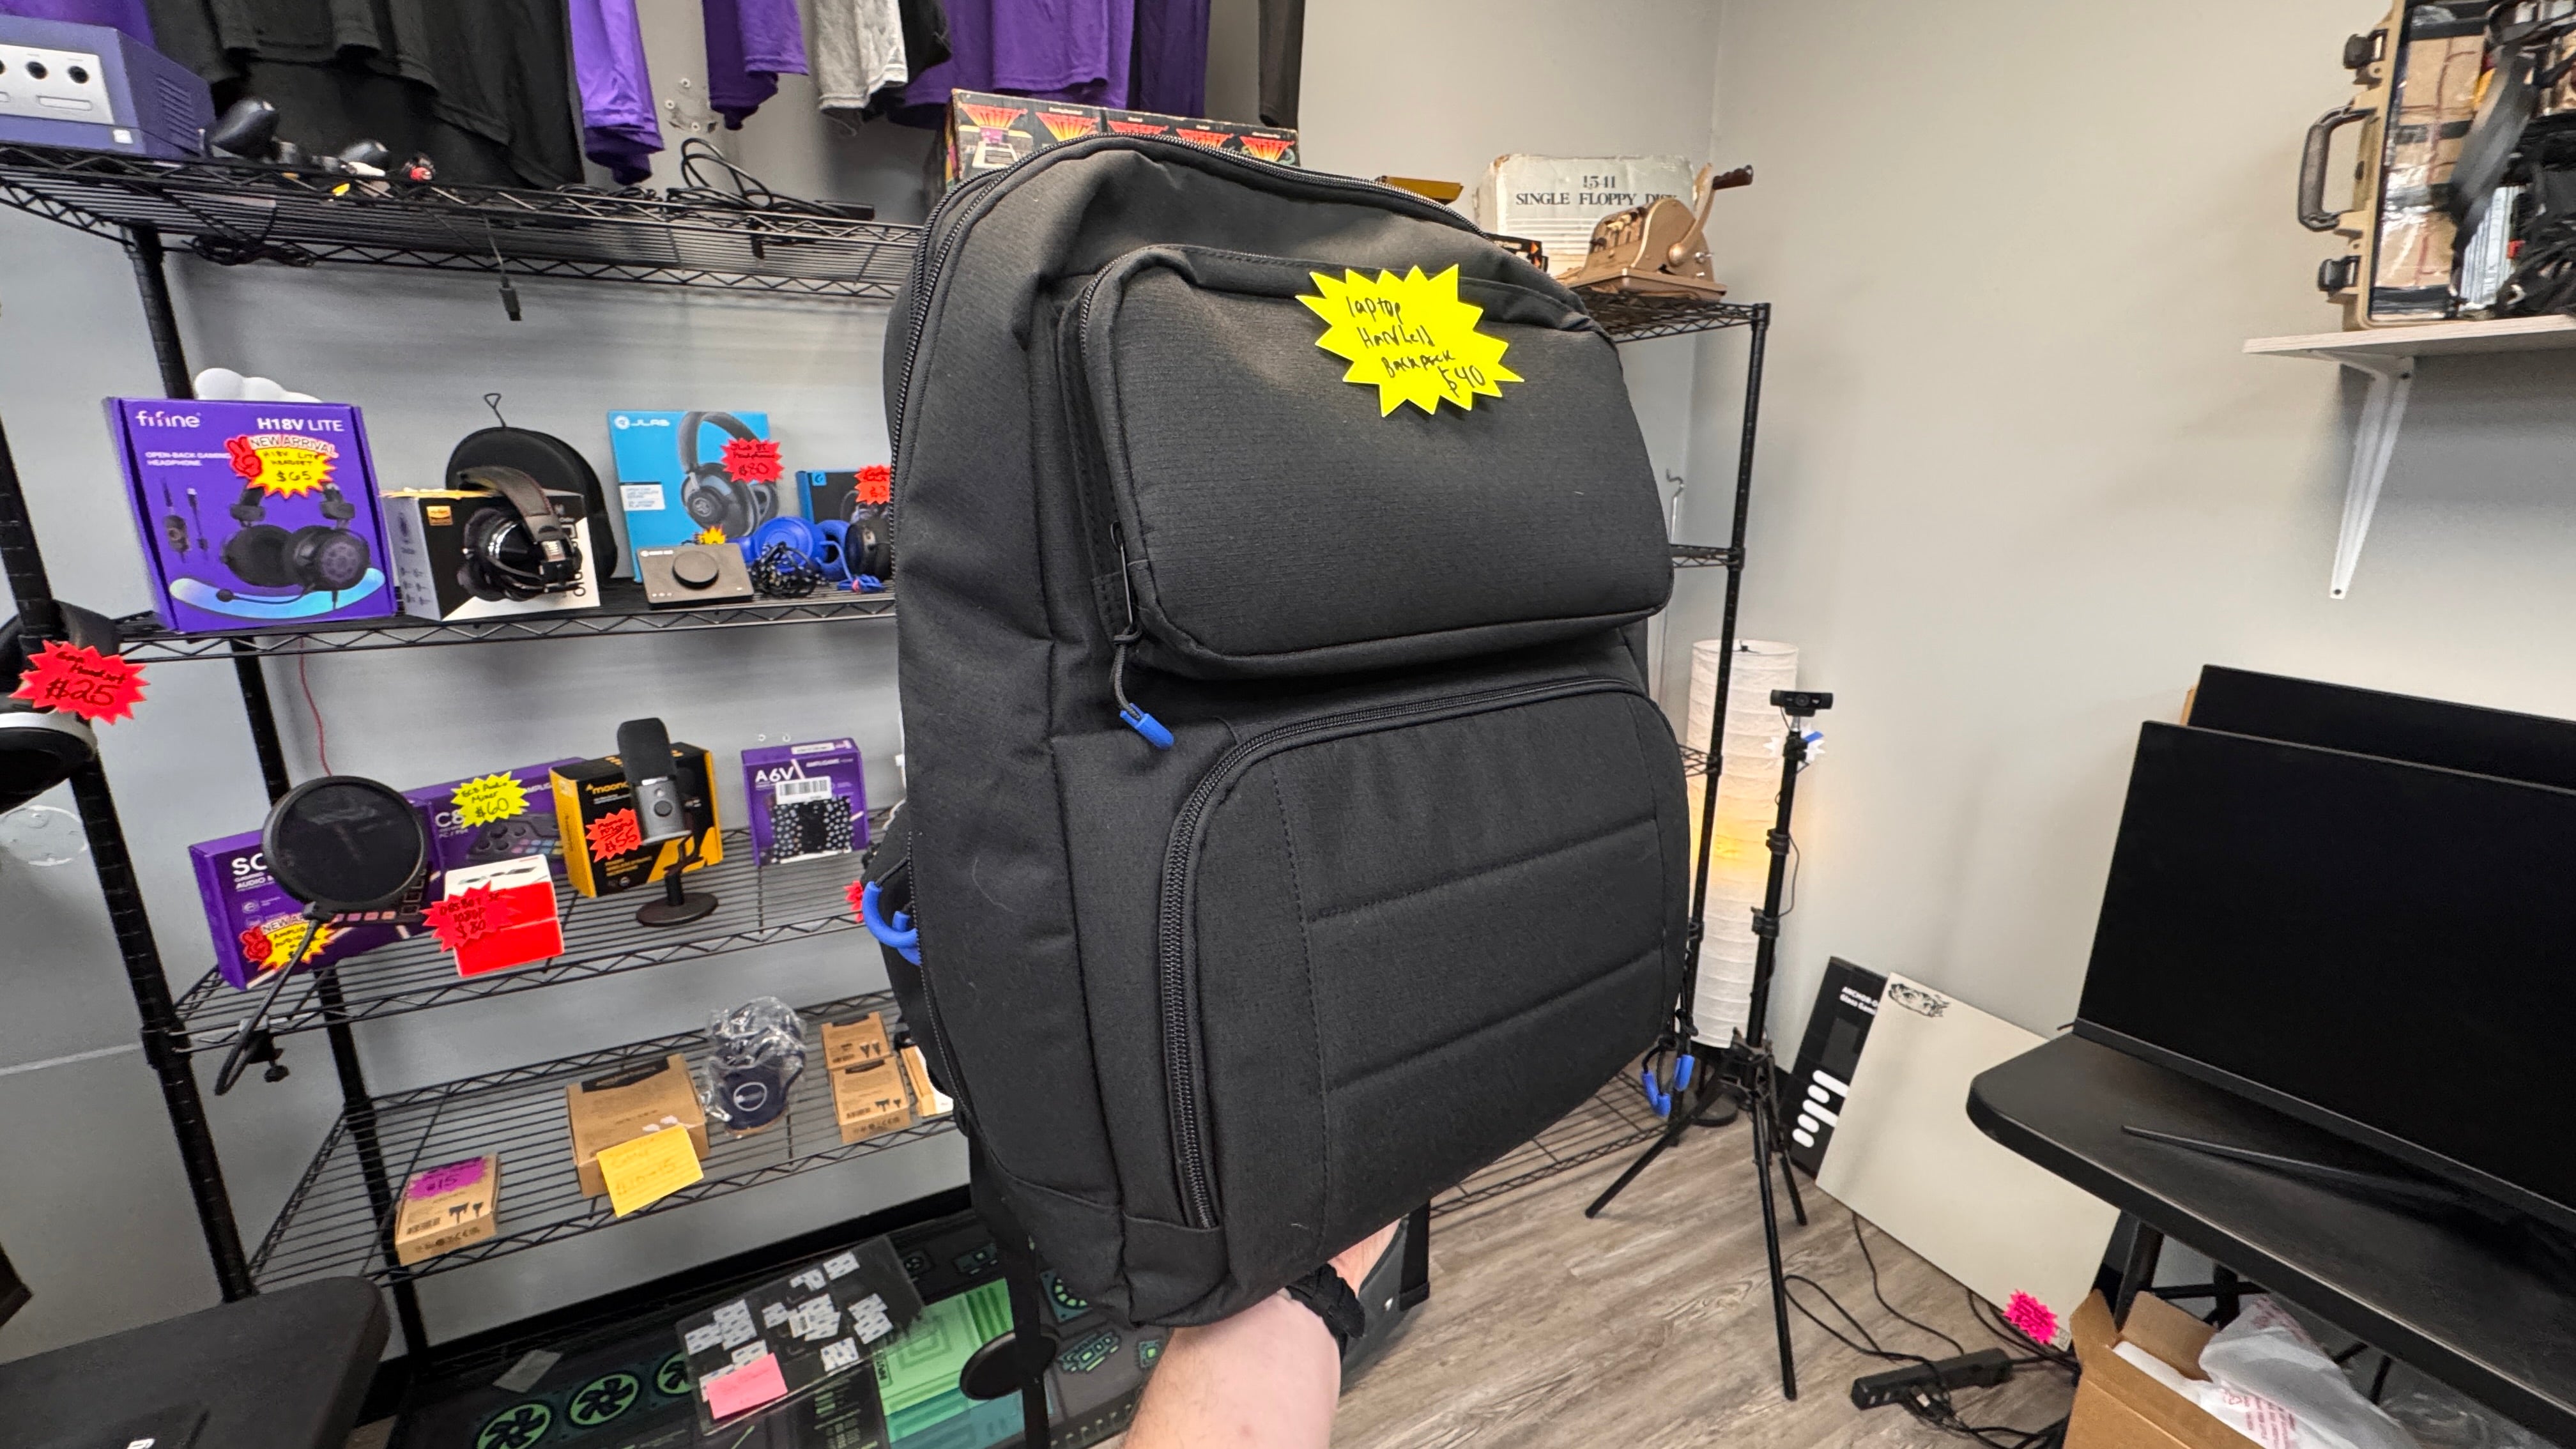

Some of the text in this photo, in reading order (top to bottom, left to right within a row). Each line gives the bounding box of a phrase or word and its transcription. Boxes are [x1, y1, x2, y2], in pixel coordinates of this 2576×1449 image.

[1515, 192, 1570, 205] SINGLE
[1579, 192, 1637, 206] FLOPPY
[1438, 365, 1485, 399] $40
[135, 410, 201, 428] fifine
[257, 417, 345, 432] H18V LITE
[250, 435, 335, 456] NEW ARRIVAL
[276, 470, 312, 482] $65
[739, 463, 770, 477] $80
[755, 767, 795, 783] A6V
[475, 798, 509, 818] $60
